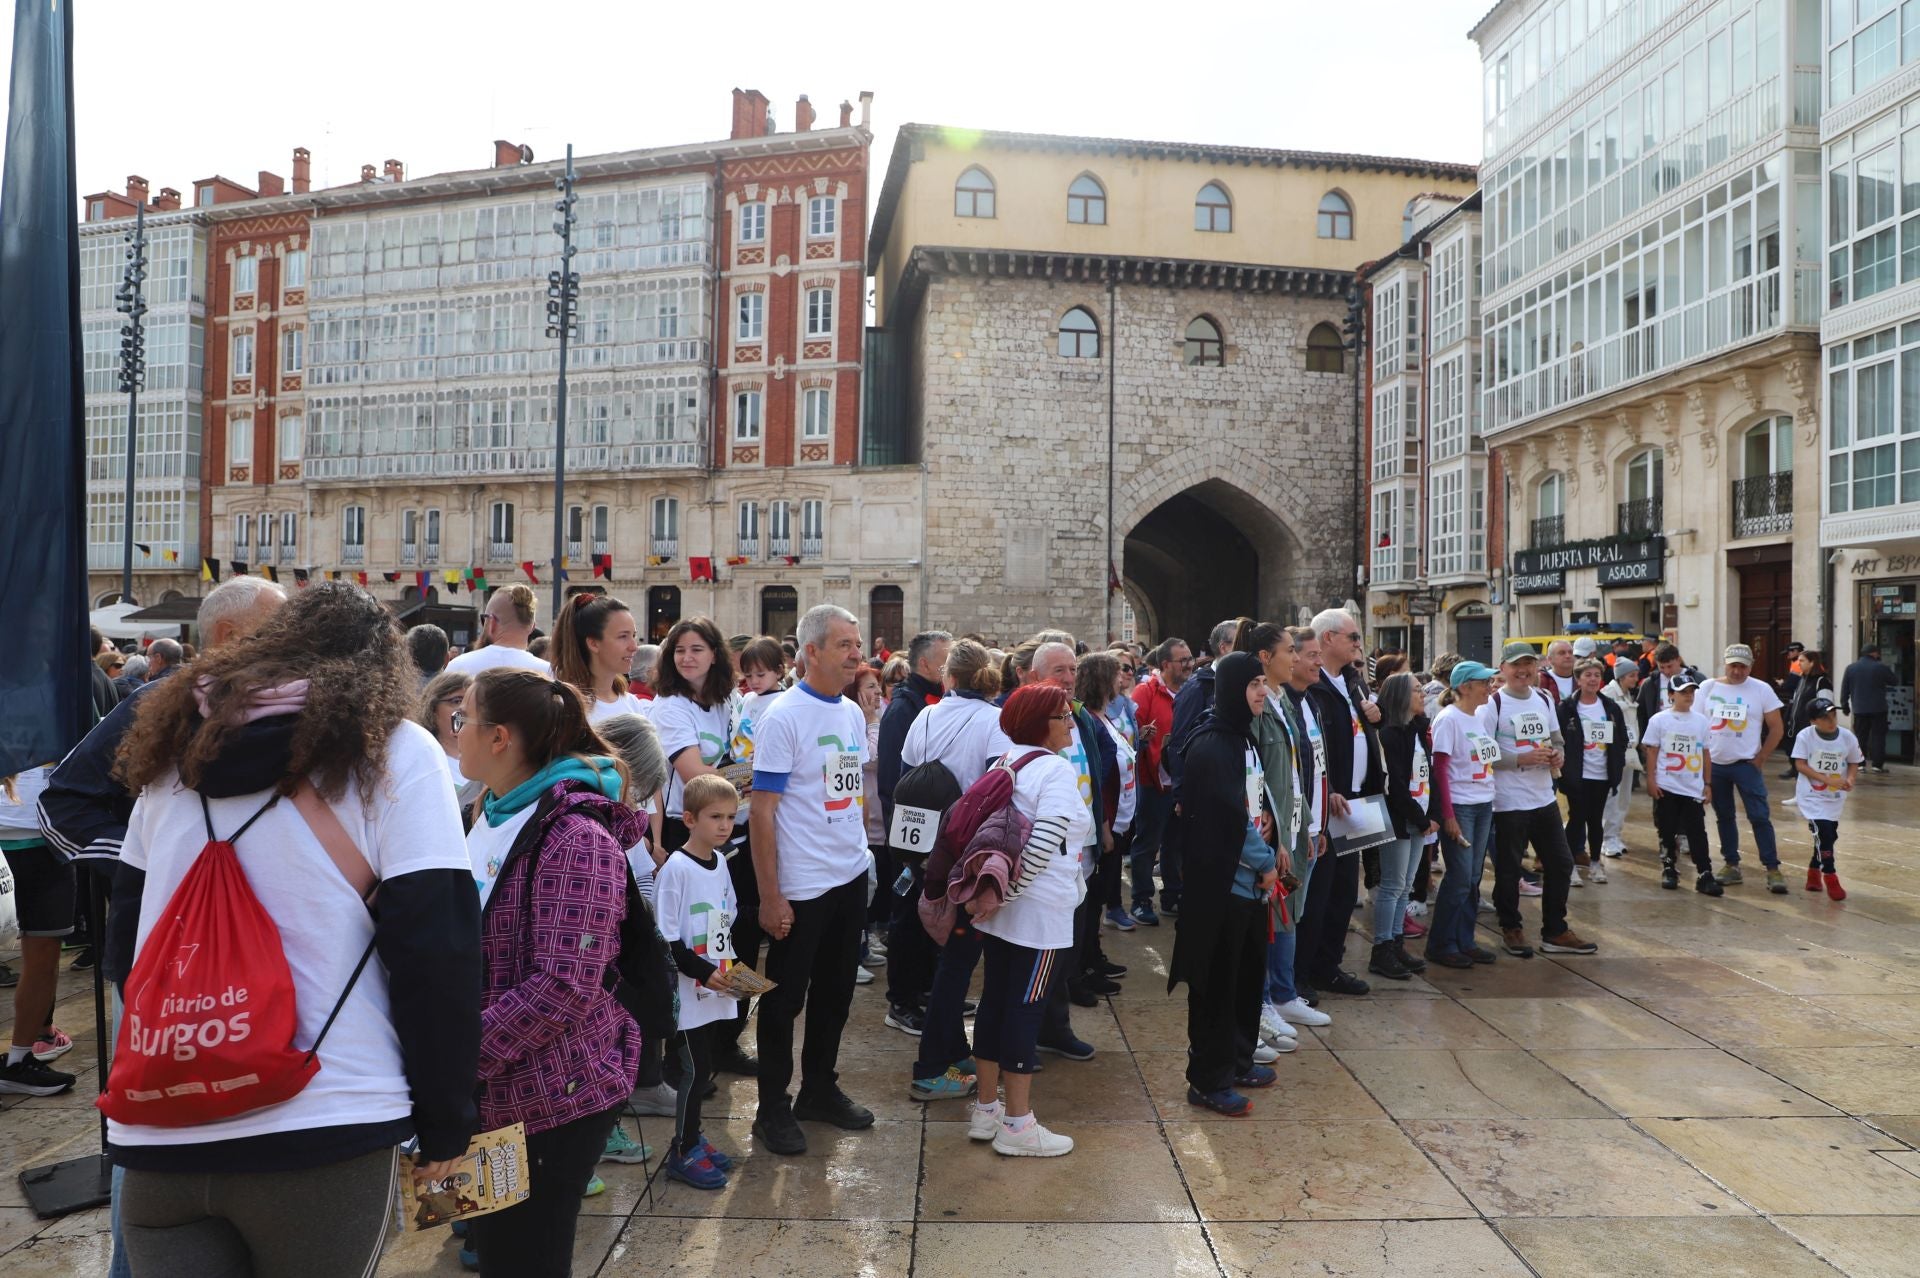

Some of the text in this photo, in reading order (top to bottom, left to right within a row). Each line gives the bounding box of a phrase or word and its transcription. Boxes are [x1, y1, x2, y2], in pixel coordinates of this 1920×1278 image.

[1540, 544, 1623, 570] PUERTA REAL
[1608, 563, 1647, 581] ASADOR
[1851, 559, 1880, 576] ART
[1521, 723, 1543, 736] 499
[1591, 730, 1605, 740] 59
[1481, 745, 1497, 760] 500
[1671, 742, 1691, 753] 121
[1817, 761, 1838, 771] 120
[834, 772, 860, 792] 309
[902, 808, 925, 818] Semana
[901, 826, 921, 845] 16
[160, 986, 248, 1018] Diario de
[129, 1011, 251, 1062] Burgos
